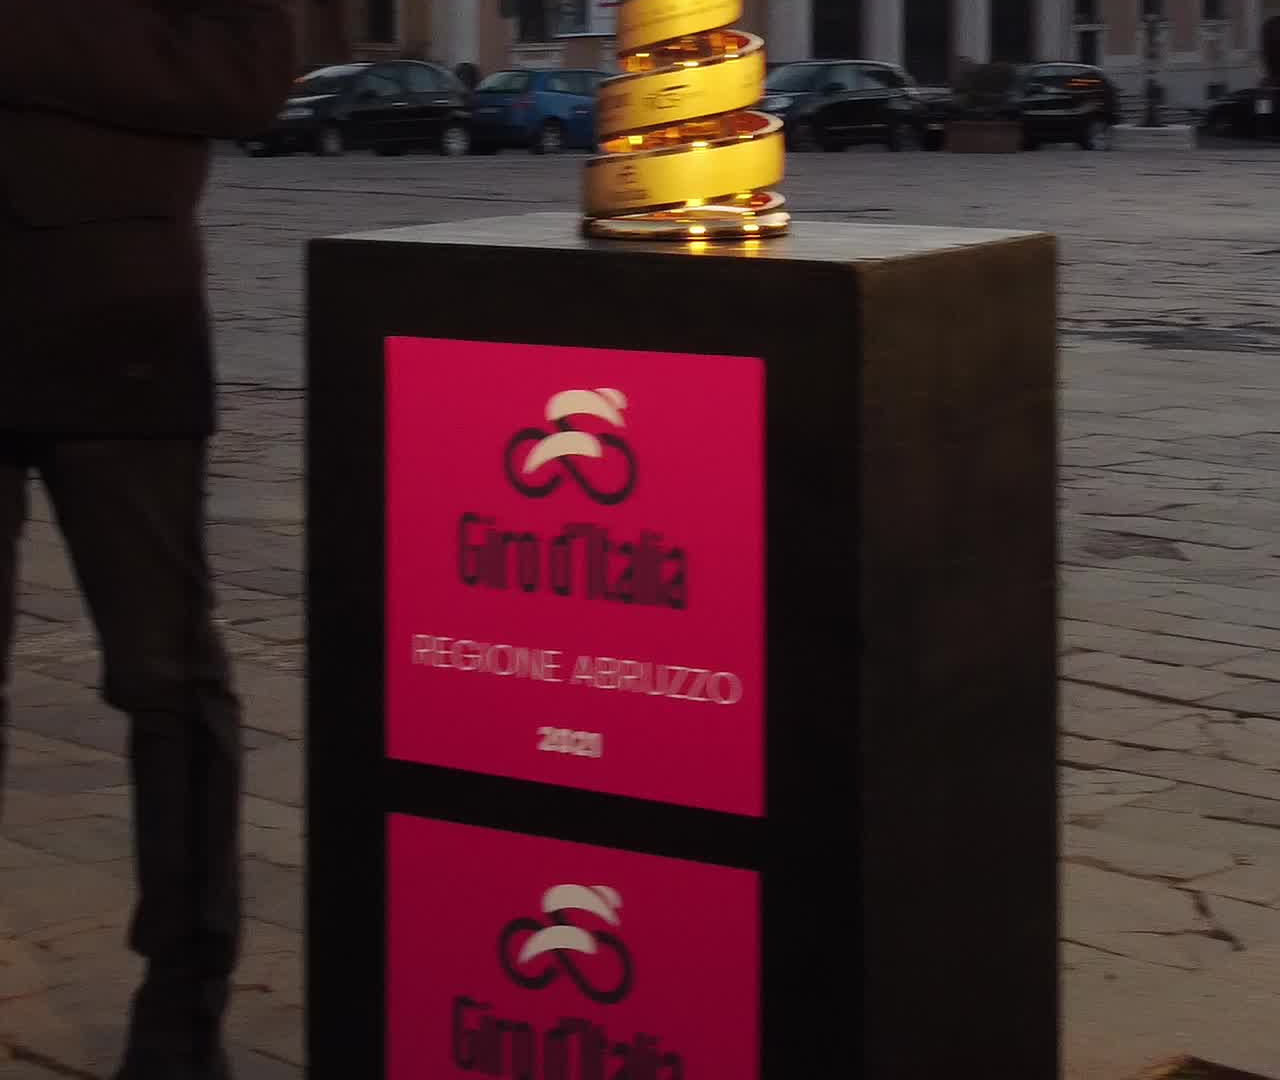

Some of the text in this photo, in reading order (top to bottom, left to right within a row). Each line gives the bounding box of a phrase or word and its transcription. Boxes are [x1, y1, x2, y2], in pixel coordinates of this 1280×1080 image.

[459, 512, 686, 609] Giro d'Italia
[412, 634, 742, 705] REGIONE ABRUZZO
[452, 996, 535, 1080] Giro
